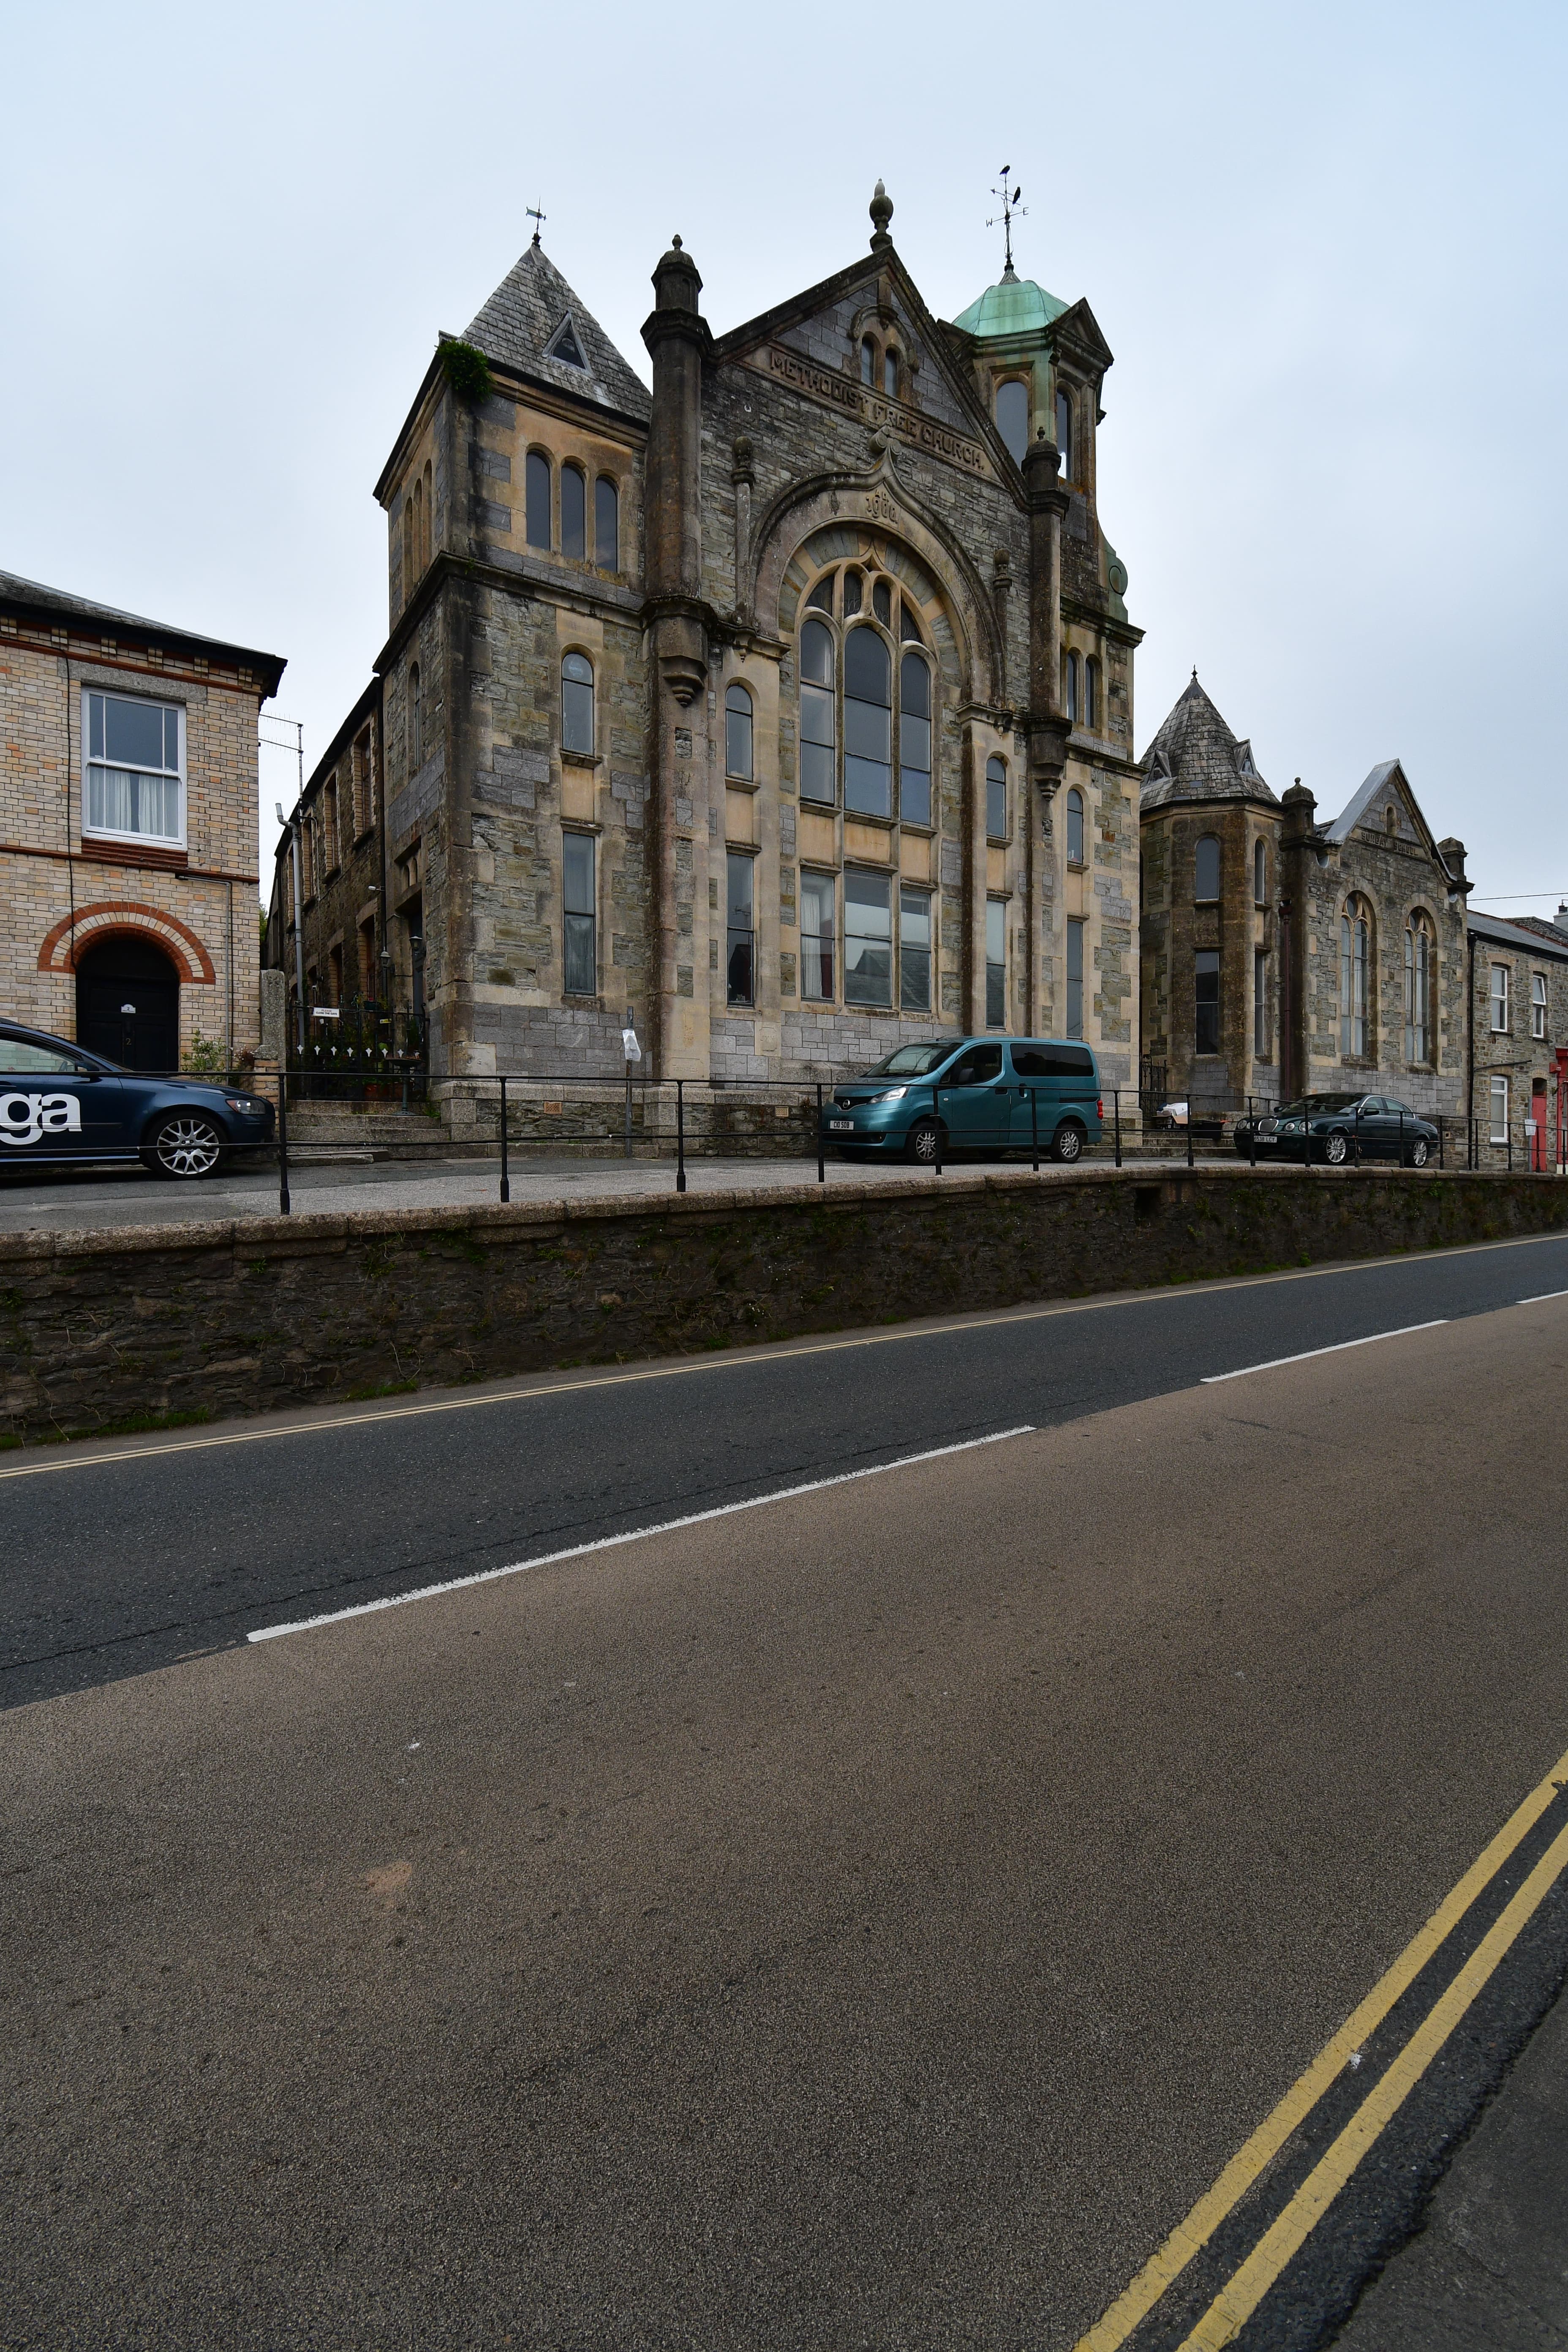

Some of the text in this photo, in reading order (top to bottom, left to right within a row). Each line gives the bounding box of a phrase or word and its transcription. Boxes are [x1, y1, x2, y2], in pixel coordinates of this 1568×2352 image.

[1023, 207, 1029, 215] E
[986, 218, 993, 227] W
[770, 351, 868, 413] METHODIST
[873, 402, 917, 438] FREE
[1361, 832, 1418, 856] SUNDAY SCHOOL
